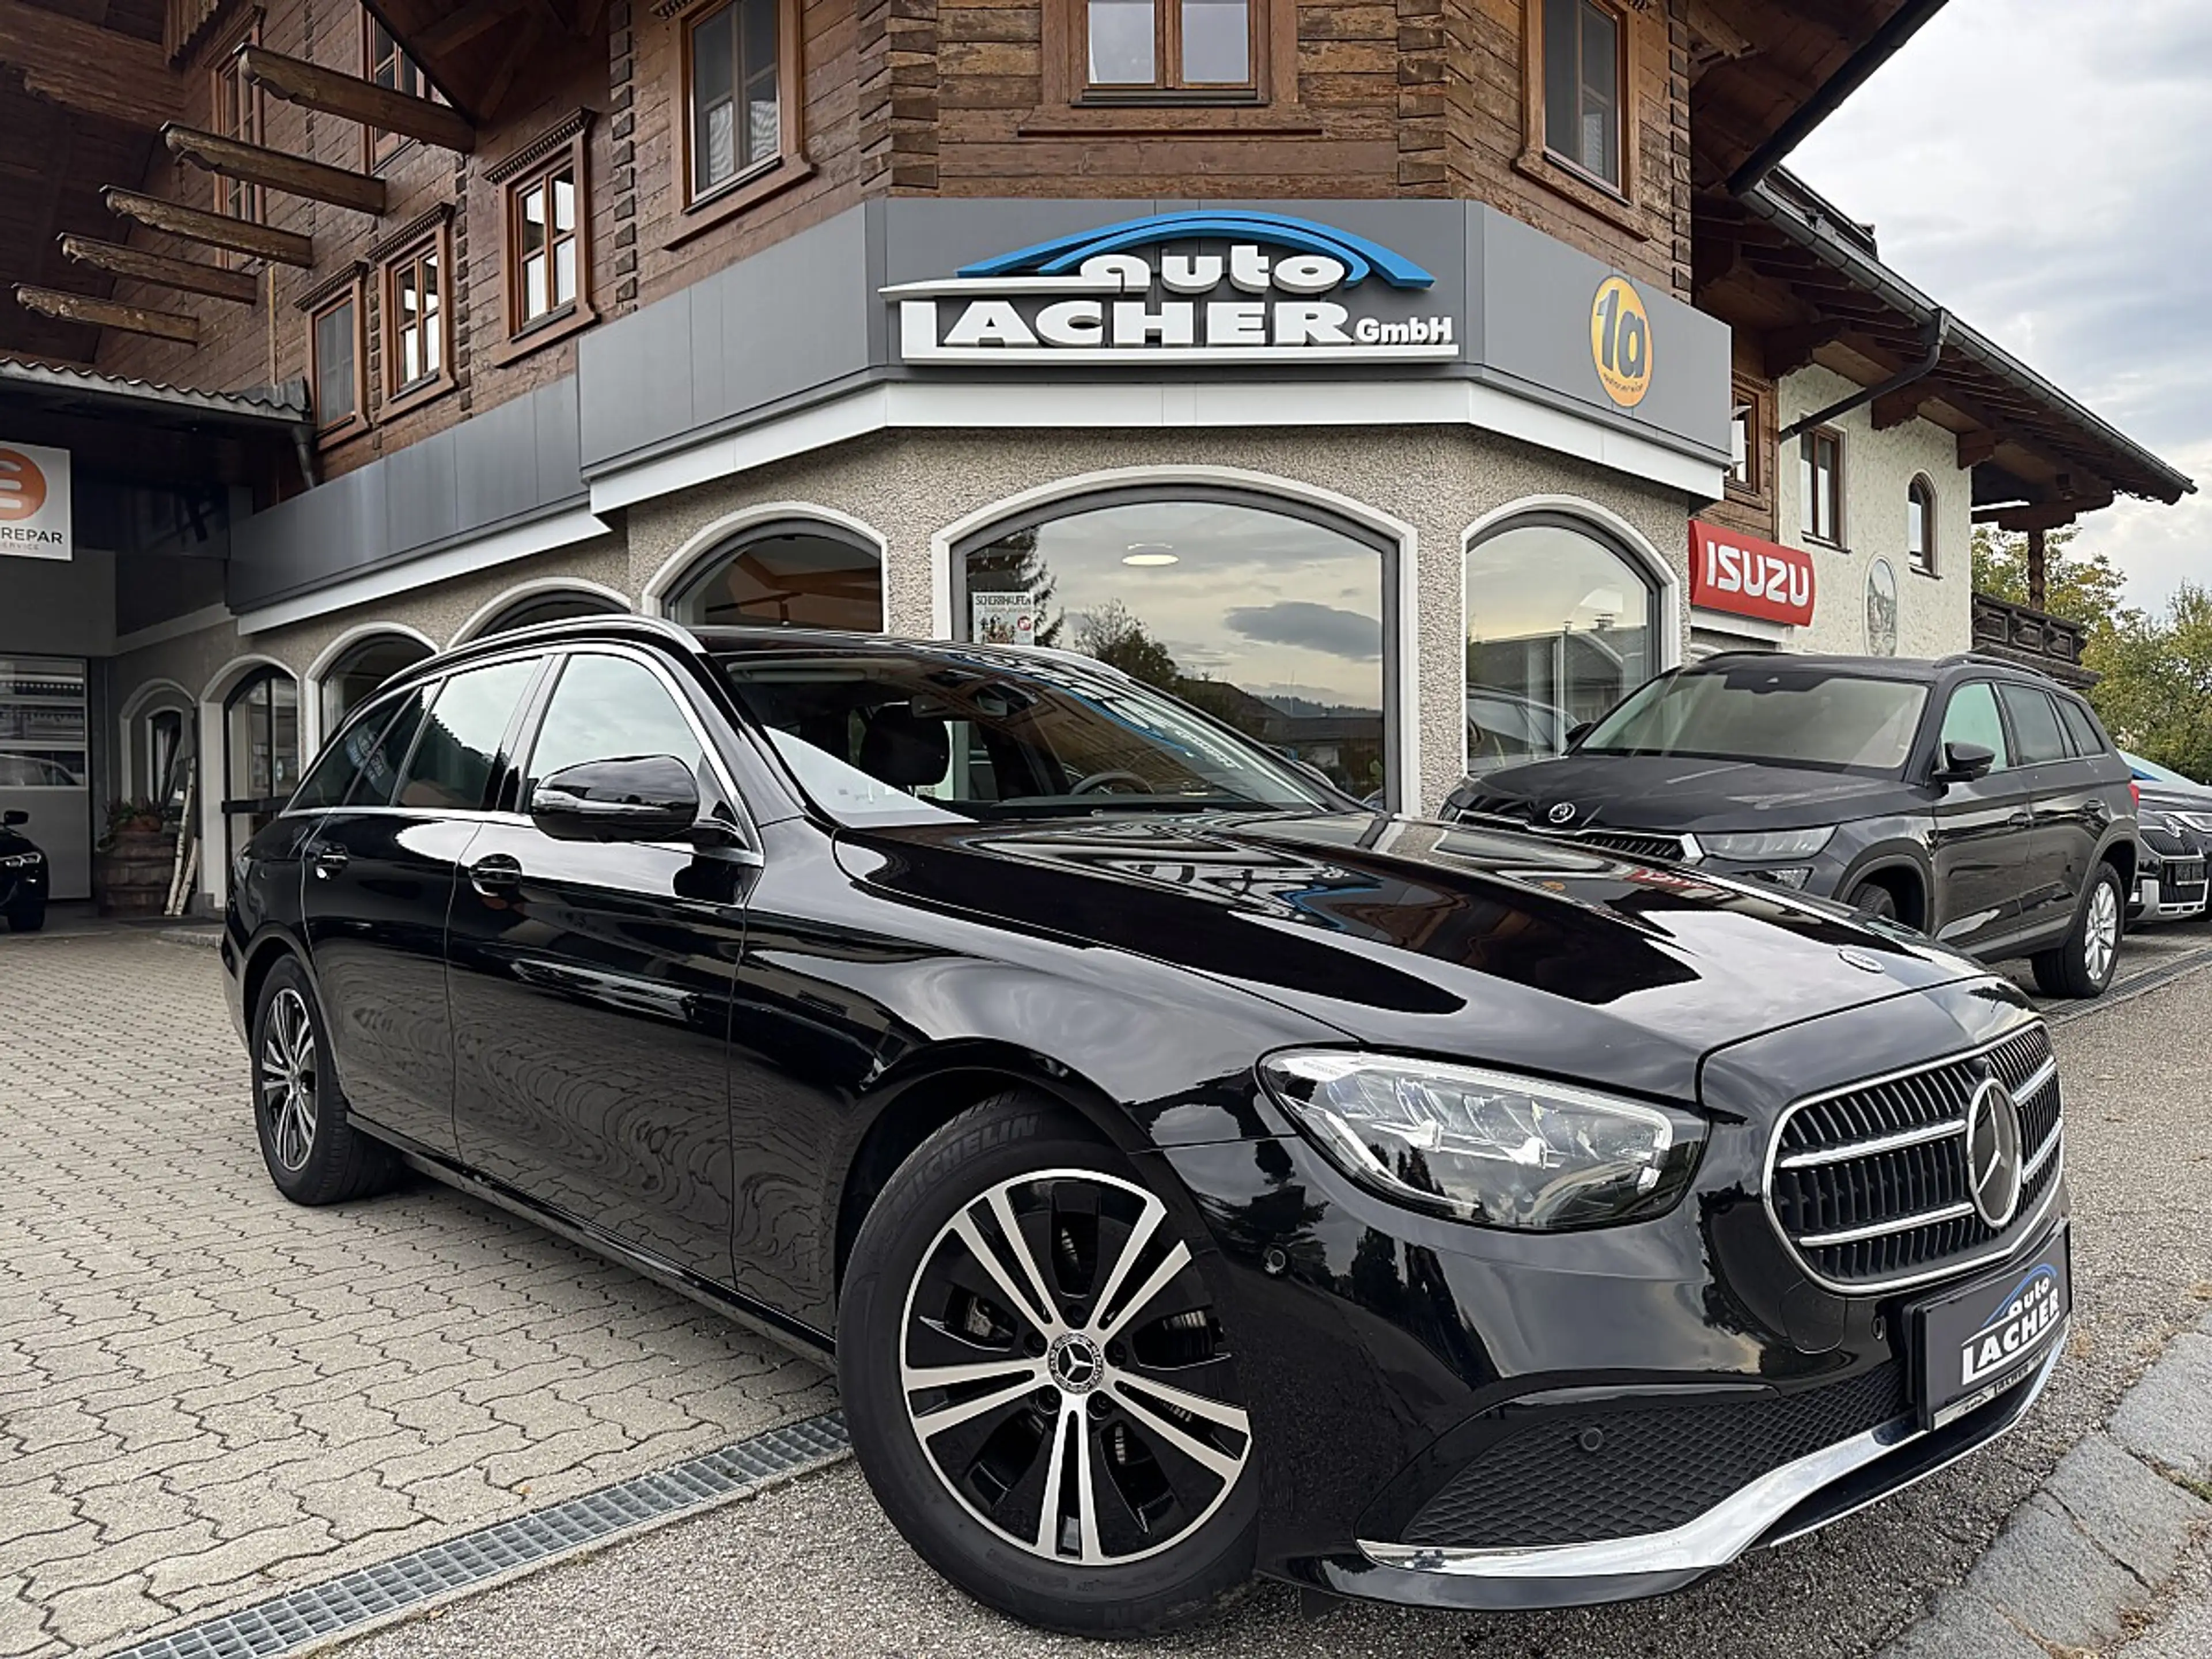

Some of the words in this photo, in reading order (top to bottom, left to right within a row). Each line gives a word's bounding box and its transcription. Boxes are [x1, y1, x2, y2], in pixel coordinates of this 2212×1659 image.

[1079, 244, 1346, 295] auto
[900, 299, 1355, 359] LACHER
[1355, 316, 1454, 345] GmbH
[1706, 540, 1809, 608] ISUZU
[2008, 1277, 2050, 1316] auto
[1961, 1287, 2060, 1386] LACHER
